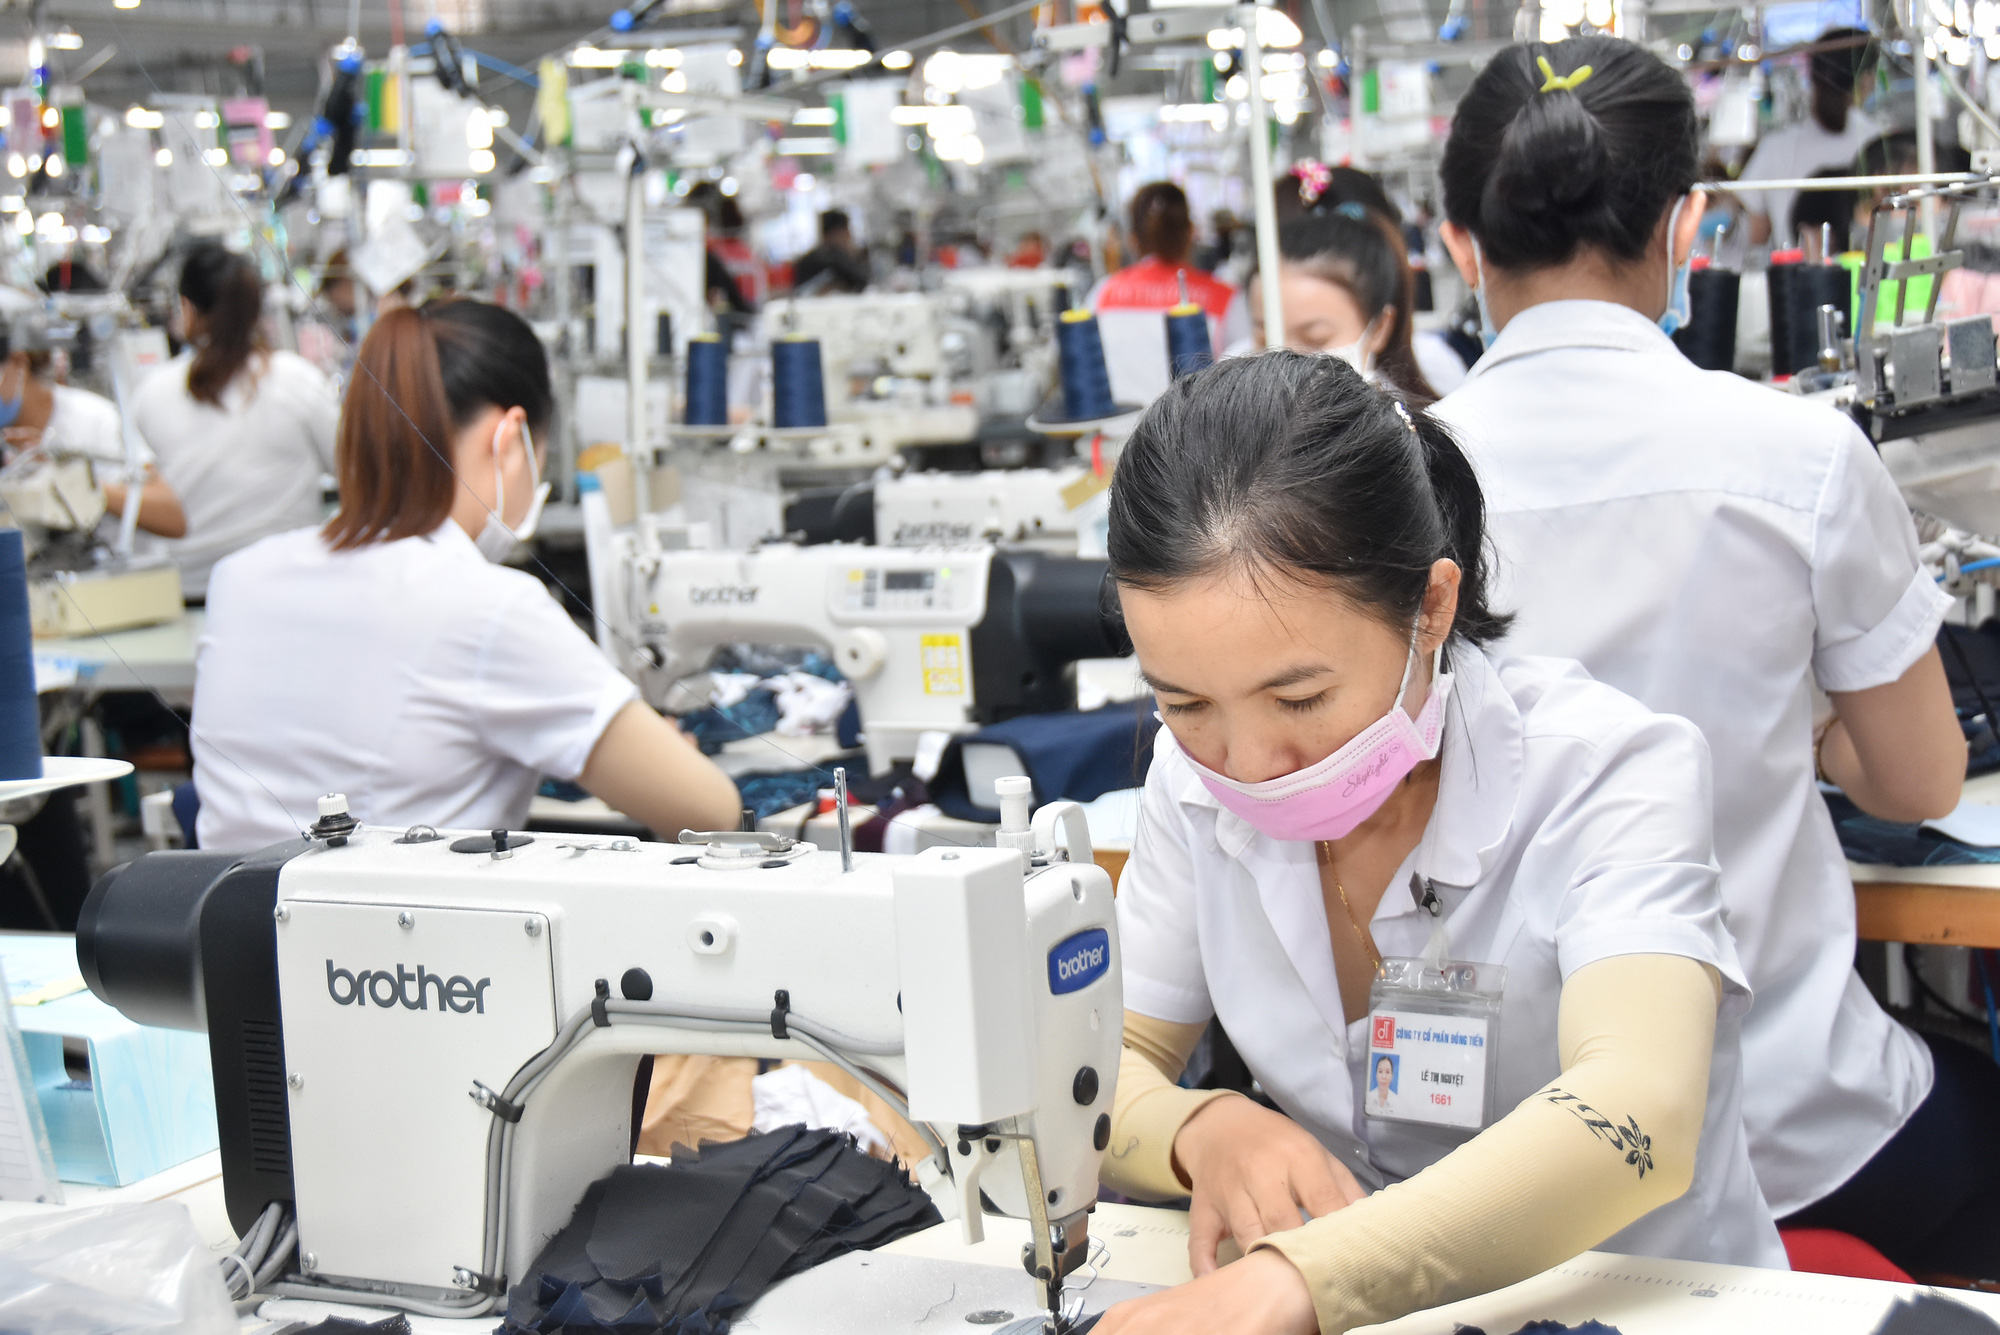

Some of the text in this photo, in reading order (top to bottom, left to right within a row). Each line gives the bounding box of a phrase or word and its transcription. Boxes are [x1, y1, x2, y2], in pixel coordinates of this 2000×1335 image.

[1058, 945, 1104, 980] brother
[326, 959, 491, 1014] brother
[1413, 1030, 1421, 1041] TY
[1430, 1093, 1451, 1106] 1661
